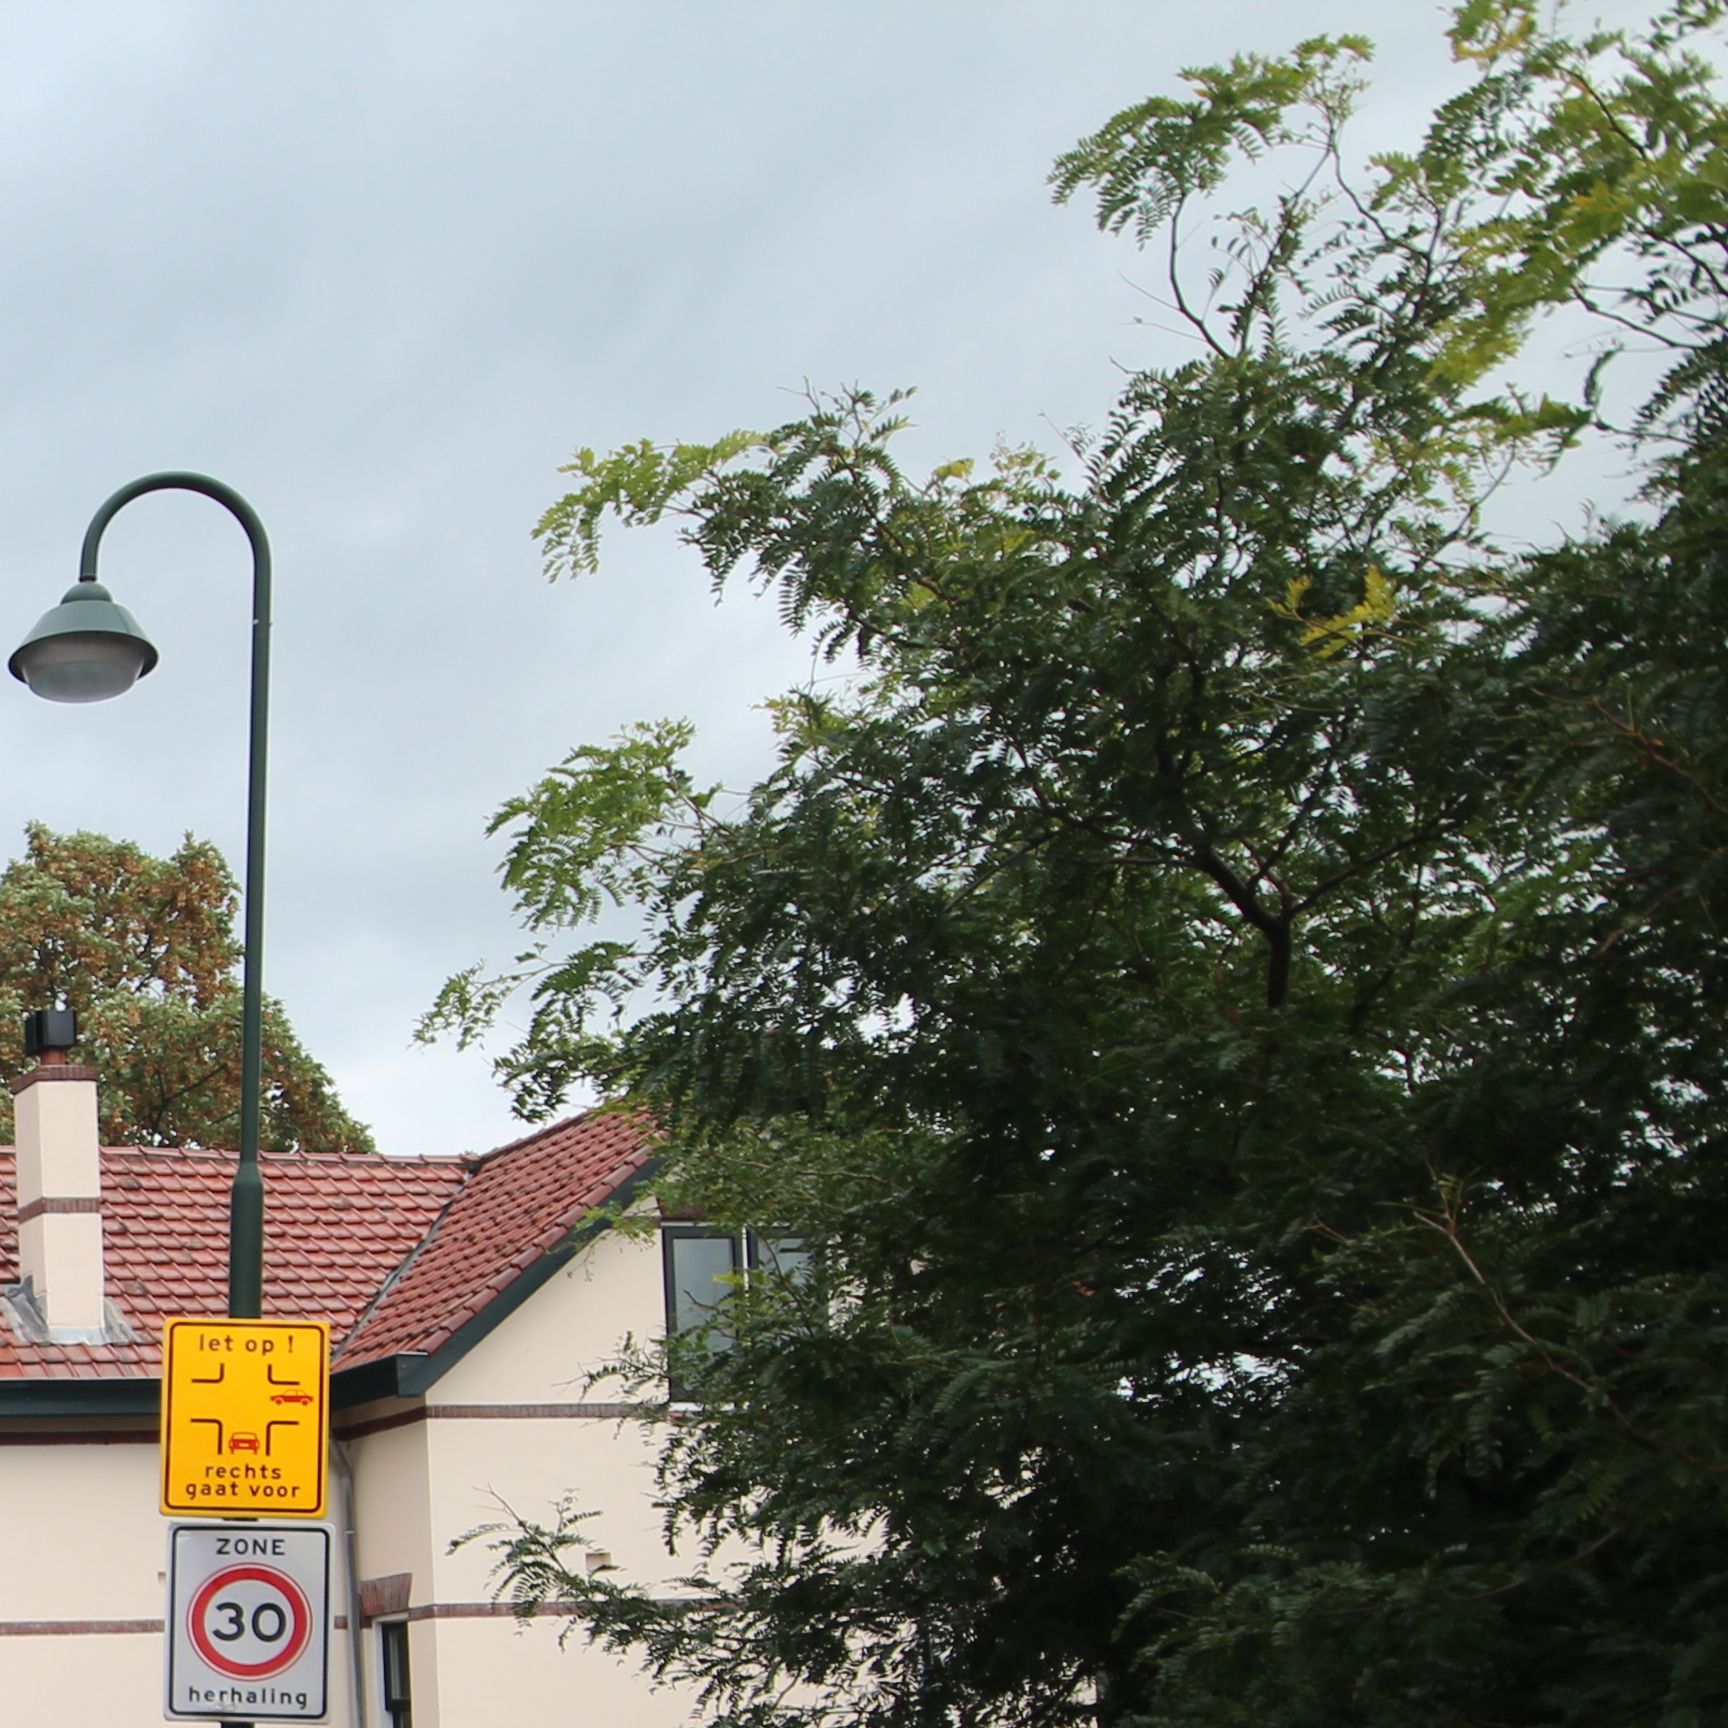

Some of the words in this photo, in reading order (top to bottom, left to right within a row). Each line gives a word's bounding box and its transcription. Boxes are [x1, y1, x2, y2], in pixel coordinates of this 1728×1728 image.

[199, 1333, 234, 1352] let
[245, 1339, 275, 1356] op
[287, 1334, 294, 1353] !
[205, 1463, 282, 1480] rechts
[185, 1481, 238, 1500] gaat
[249, 1484, 300, 1498] voor
[216, 1538, 286, 1555] ZONE
[212, 1602, 287, 1643] 30
[189, 1686, 307, 1710] herhaling
